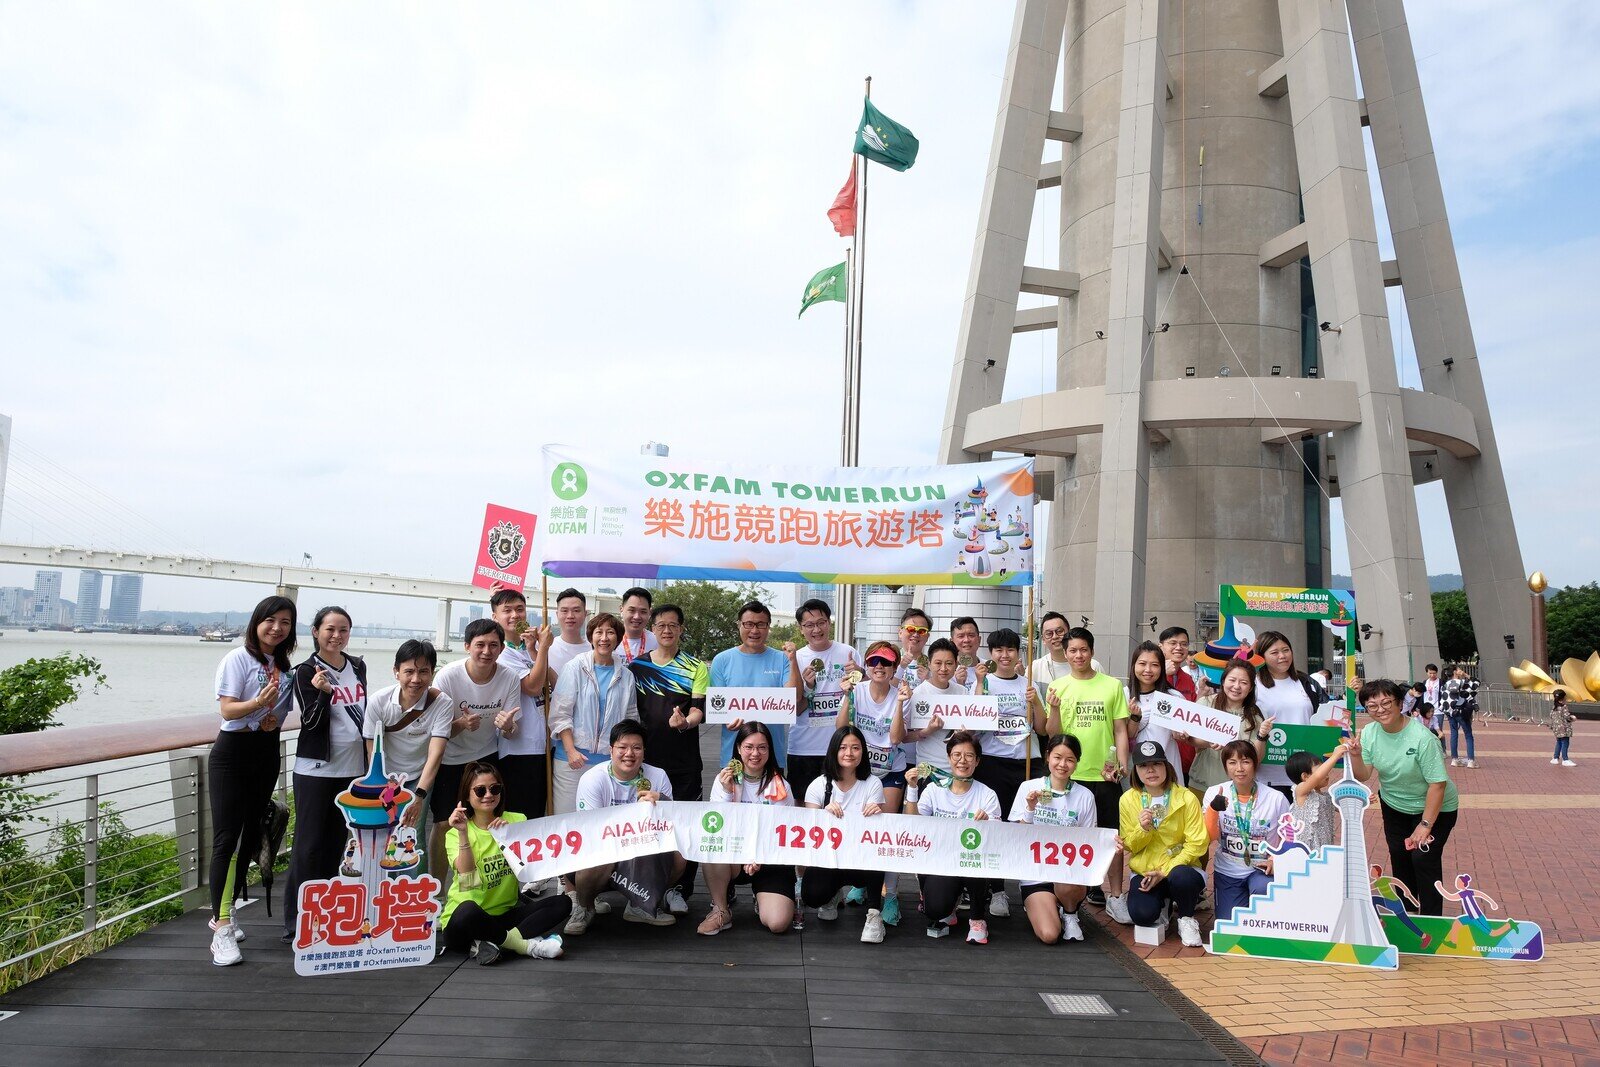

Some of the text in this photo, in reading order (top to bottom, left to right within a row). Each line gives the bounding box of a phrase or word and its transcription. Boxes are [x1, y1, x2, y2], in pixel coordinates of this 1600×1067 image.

[645, 470, 946, 504] OXFAM TOWERRUN
[550, 505, 588, 519] 樂施會
[548, 522, 588, 534] OXFAM
[601, 522, 625, 530] Without
[644, 498, 944, 549] 樂施競跑旅遊塔
[600, 529, 623, 537] Poverty
[1246, 591, 1328, 601] OXFAM TOWERRUN
[332, 683, 365, 704] AIA
[728, 696, 796, 715] AIA Vitality
[932, 703, 998, 721] AIA Vitality
[1076, 706, 1105, 714] OXFAM
[857, 717, 876, 727] XFAM
[998, 719, 1026, 729] R06A
[1173, 708, 1238, 740] AIA Vitality
[868, 750, 888, 762] 06D
[602, 816, 674, 840] AIA Vitality
[621, 833, 659, 847] 健康程式
[775, 825, 842, 850] 1299
[861, 830, 931, 852] AIA Vitality
[508, 830, 583, 863] 1299
[1227, 839, 1259, 851] R0D
[877, 847, 915, 859] 健康程式
[1030, 841, 1094, 868] 1299
[484, 859, 510, 873] OXFA
[960, 860, 981, 868] OXFAM
[485, 868, 515, 882] TOWERR
[611, 871, 650, 902] AIA Vitality
[297, 877, 437, 949] 跑塔
[1242, 918, 1329, 934] #OXFAMTOWERRUN
[366, 944, 432, 955] #OxfamTowerRun
[1472, 945, 1530, 955] #OXFAMTOWERRUN
[363, 957, 421, 967] #OxfaminMacau
